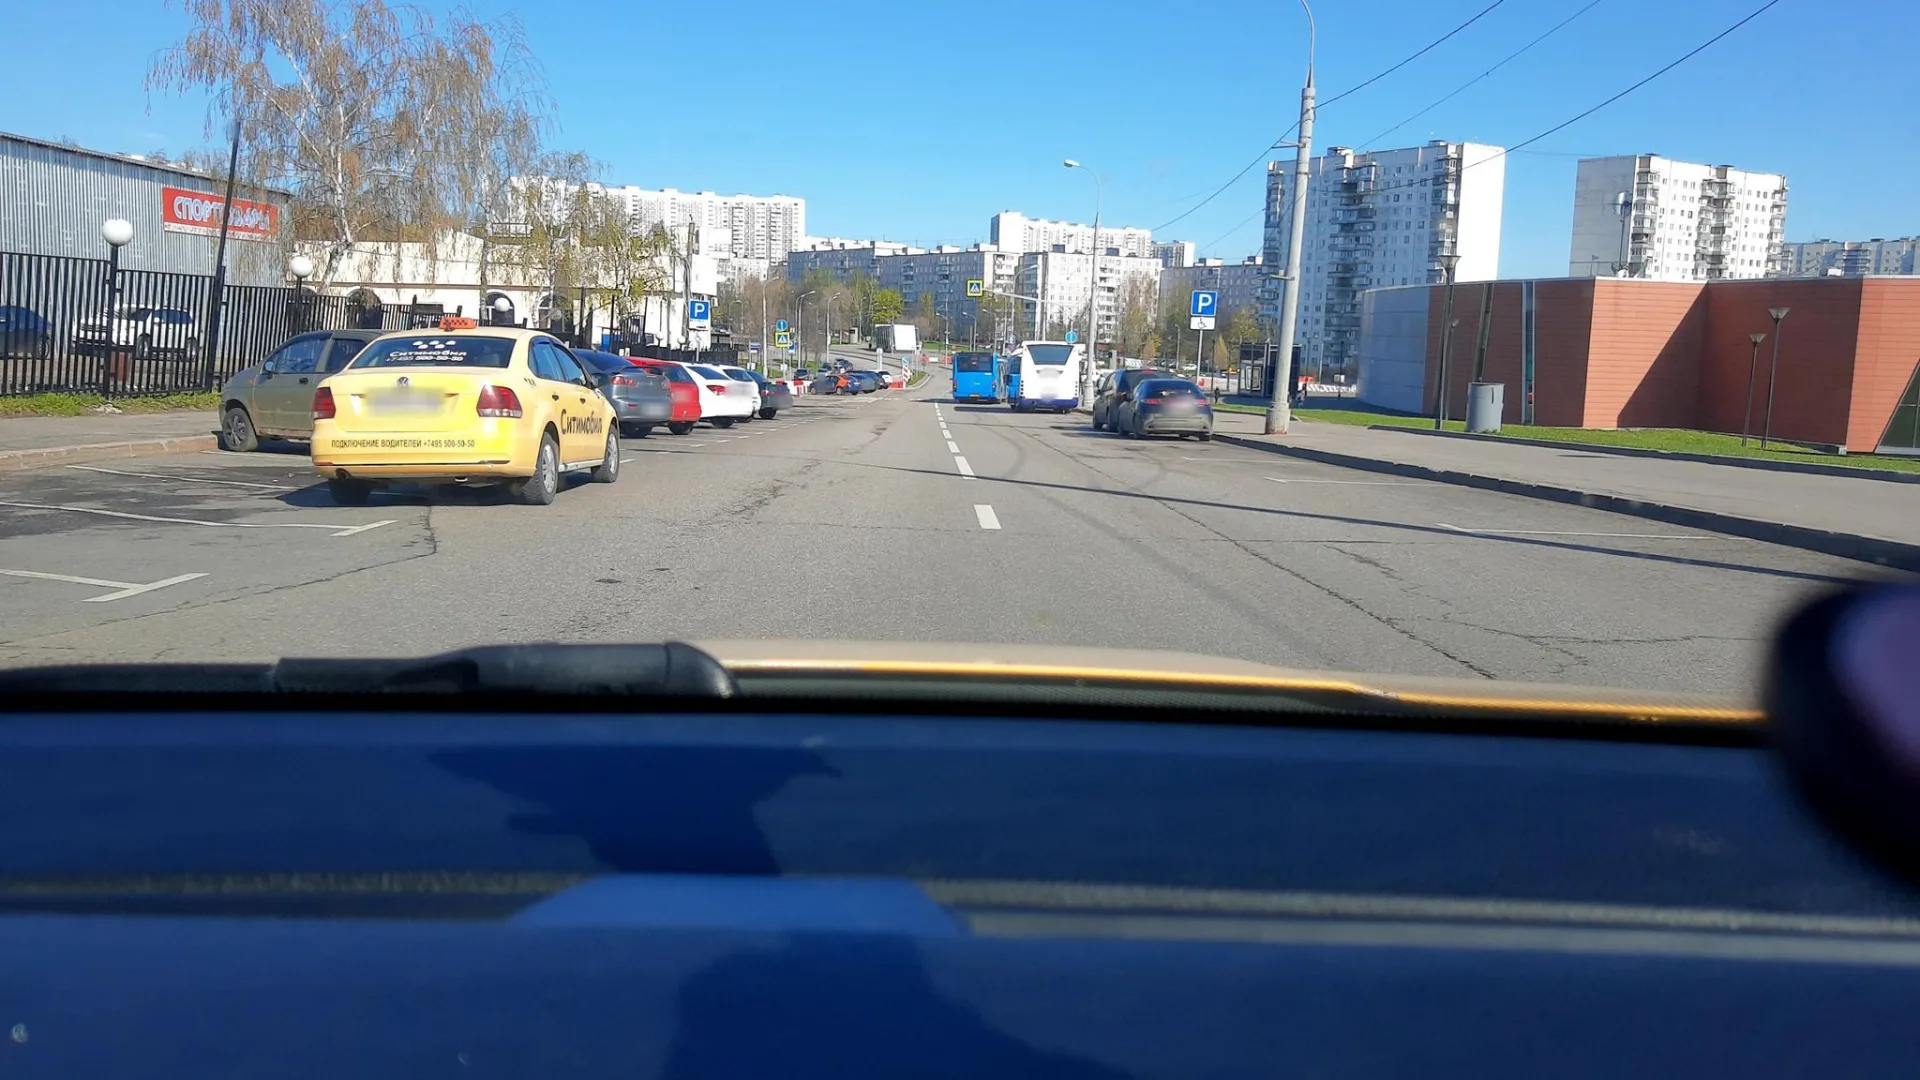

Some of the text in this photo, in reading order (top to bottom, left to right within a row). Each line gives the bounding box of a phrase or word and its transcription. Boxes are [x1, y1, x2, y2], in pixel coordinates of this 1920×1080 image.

[694, 302, 705, 318] P
[1198, 294, 1212, 313] P
[560, 408, 603, 435] Ситимобил
[331, 438, 475, 448] ПОДКЛЮЧЕНИЕ ВОДИТЕЛЕЙ +7495 500-50-50
